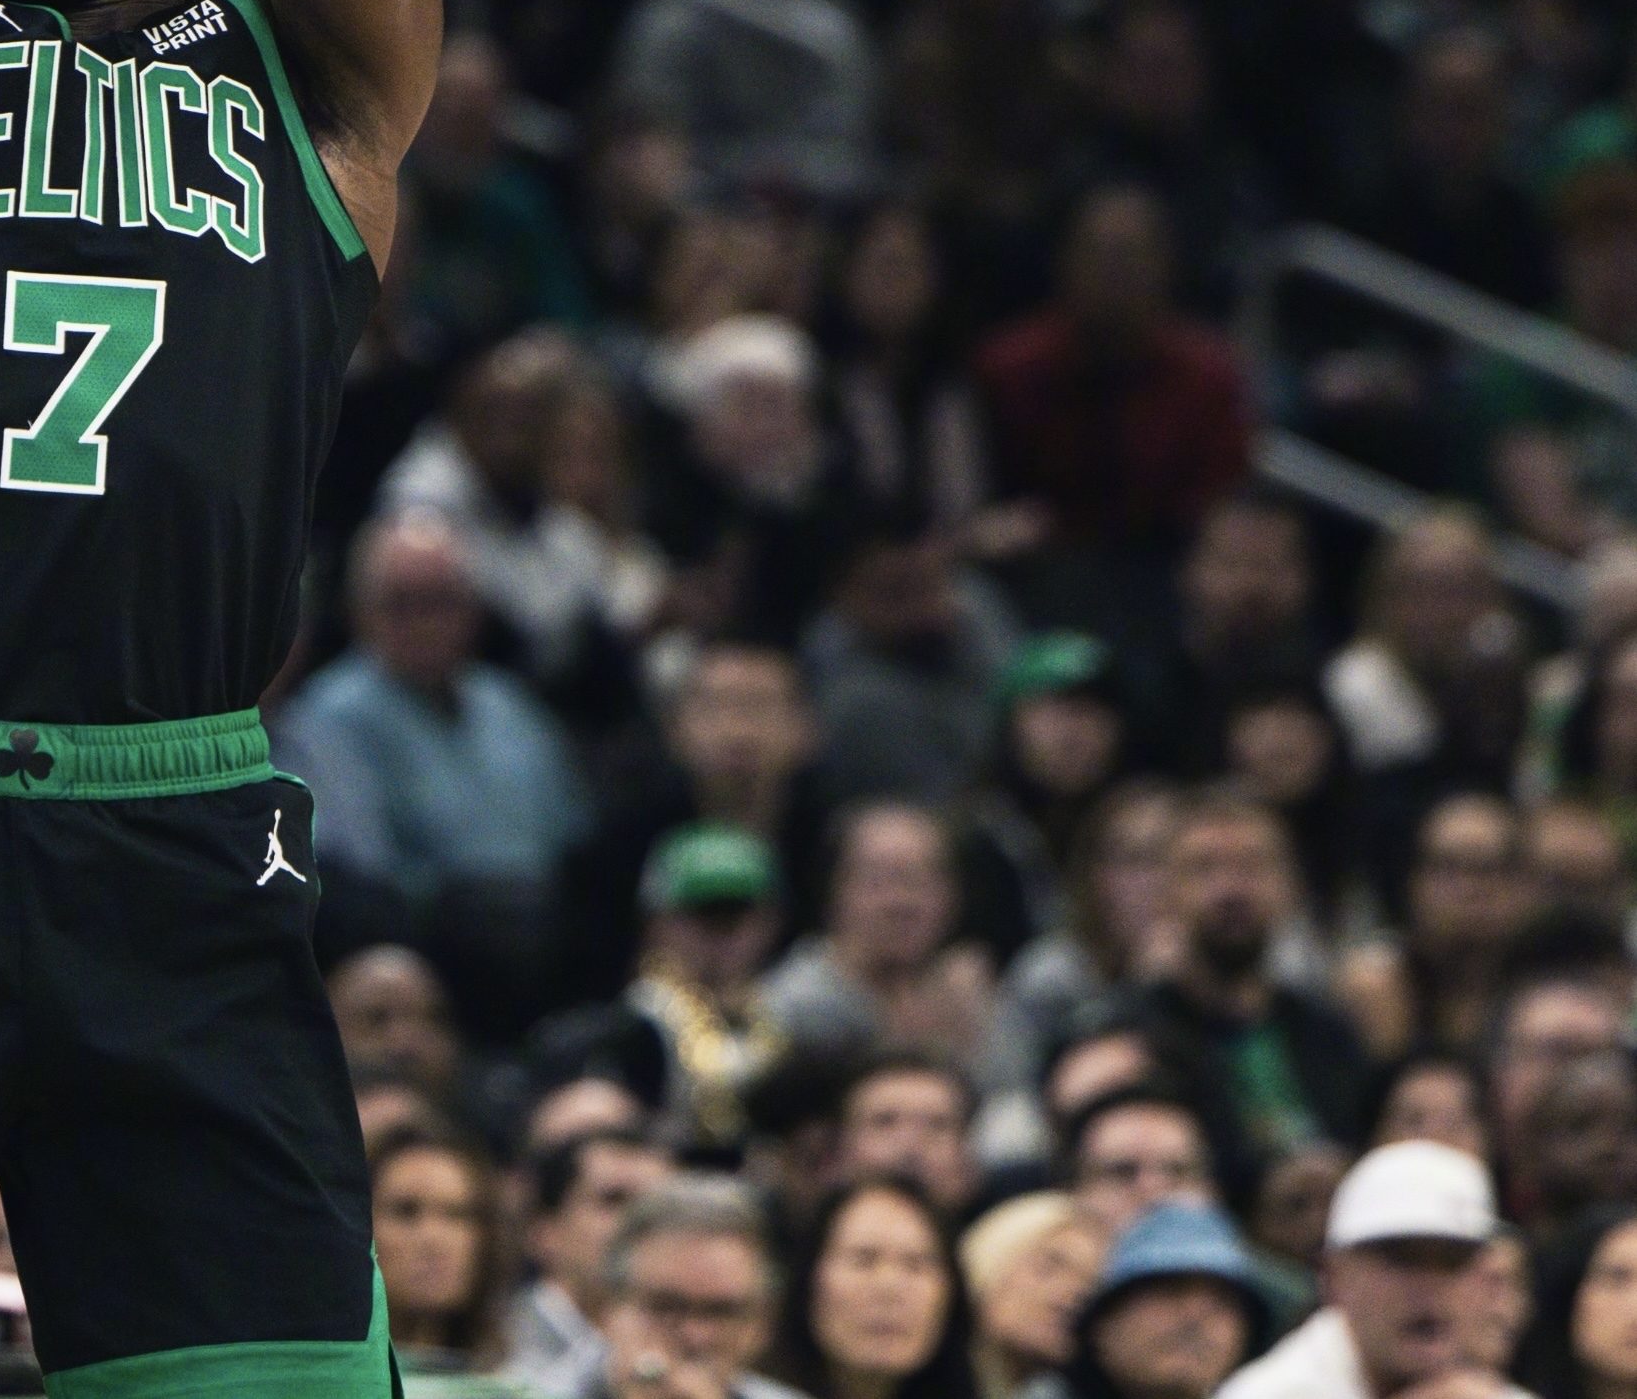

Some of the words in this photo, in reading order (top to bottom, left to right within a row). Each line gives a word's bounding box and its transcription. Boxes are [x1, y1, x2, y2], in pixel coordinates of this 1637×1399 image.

[142, 0, 222, 44] VISTA
[152, 12, 228, 55] PRINT
[0, 271, 166, 494] 7
